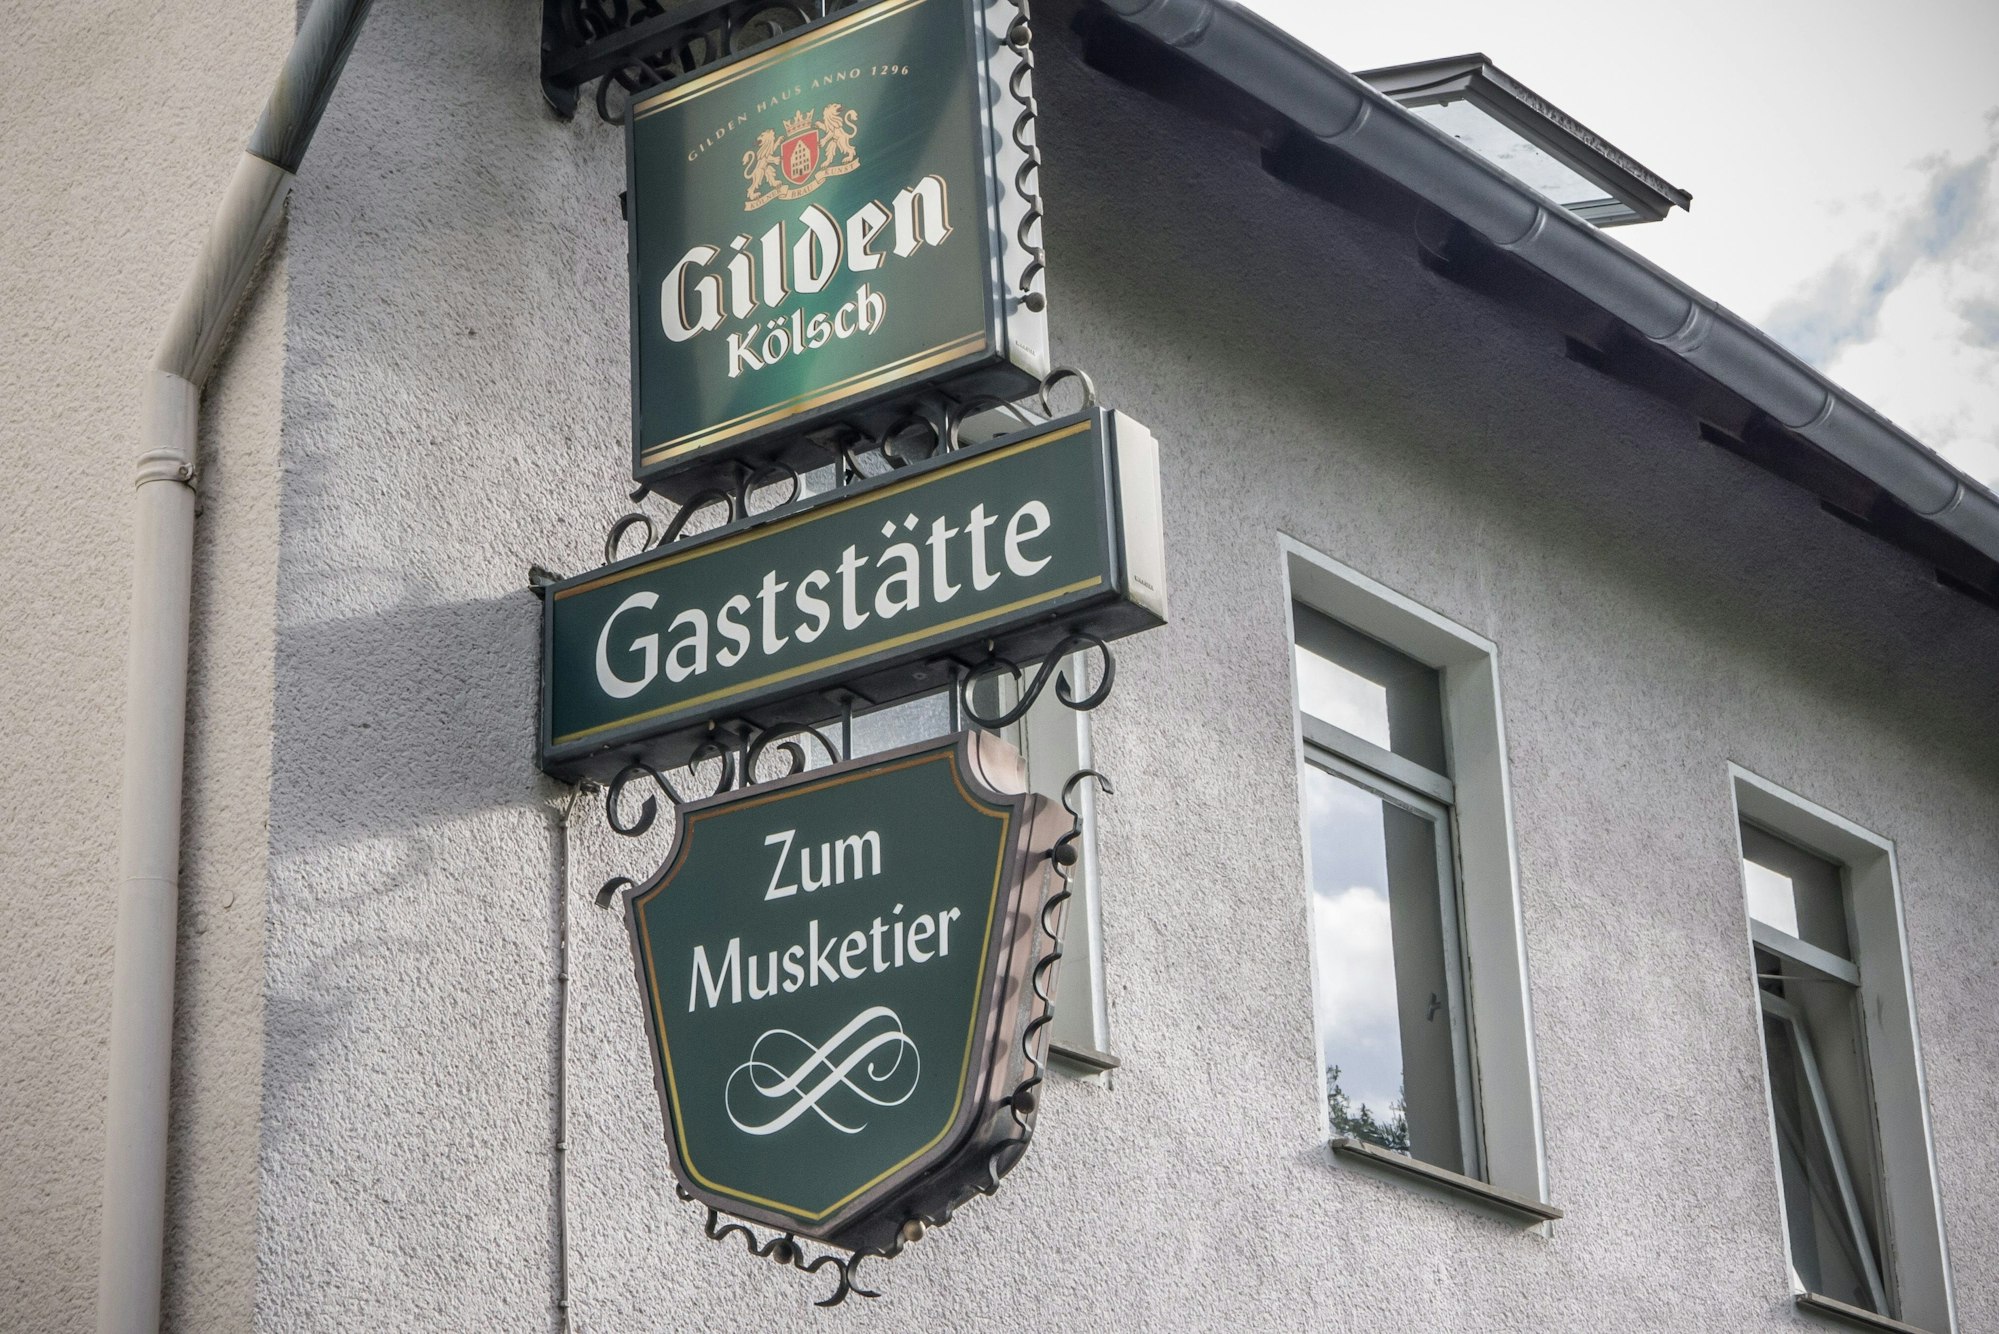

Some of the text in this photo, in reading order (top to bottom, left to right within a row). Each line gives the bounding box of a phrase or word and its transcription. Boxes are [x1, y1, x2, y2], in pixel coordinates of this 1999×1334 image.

[687, 64, 909, 162] GILDEN HAUS ANNO 1296
[660, 174, 953, 342] Gilden
[727, 281, 887, 379] Kölsch
[595, 500, 1053, 699] Gaststätte
[764, 829, 882, 901] Zum
[688, 903, 961, 1013] Musketier
